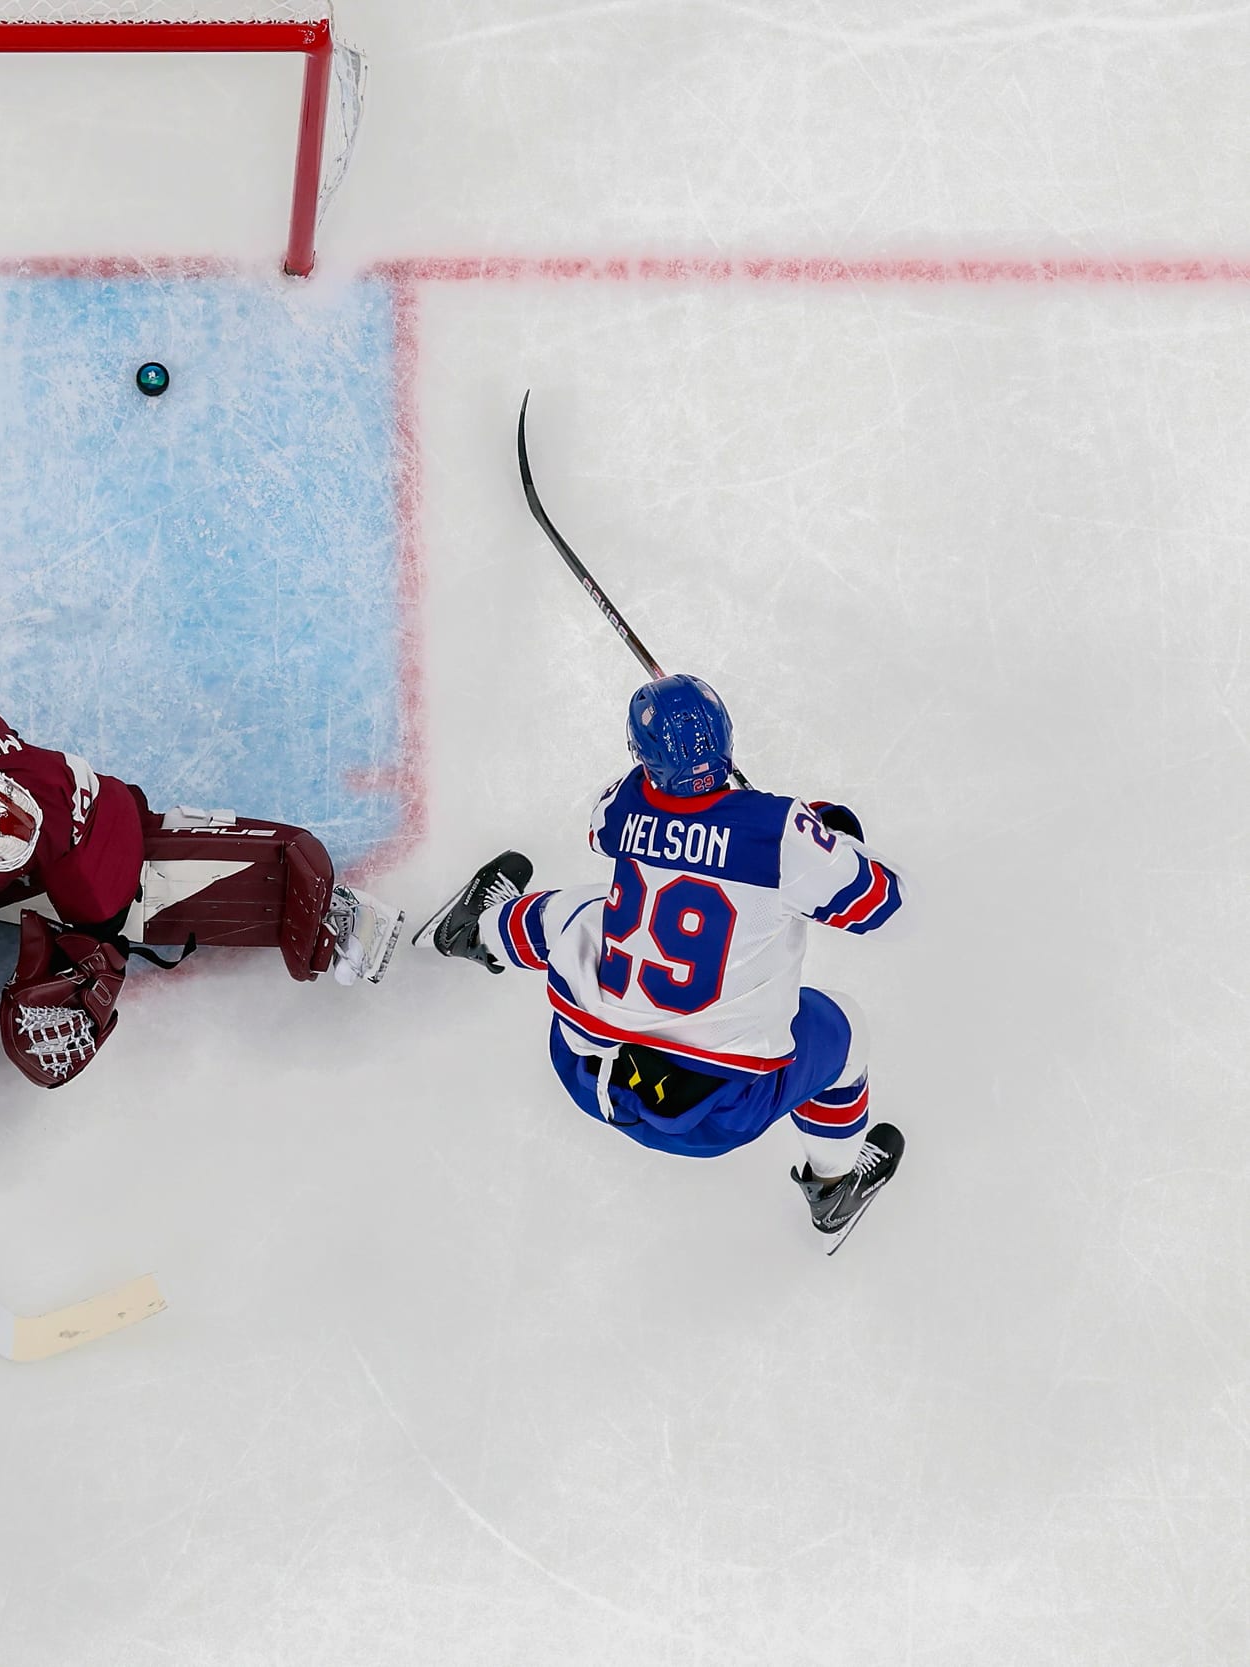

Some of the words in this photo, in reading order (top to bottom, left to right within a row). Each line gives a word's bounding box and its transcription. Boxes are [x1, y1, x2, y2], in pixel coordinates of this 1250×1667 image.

[693, 775, 715, 792] 29
[619, 812, 731, 868] NELSON
[794, 803, 837, 853] 2
[597, 858, 738, 1016] 29
